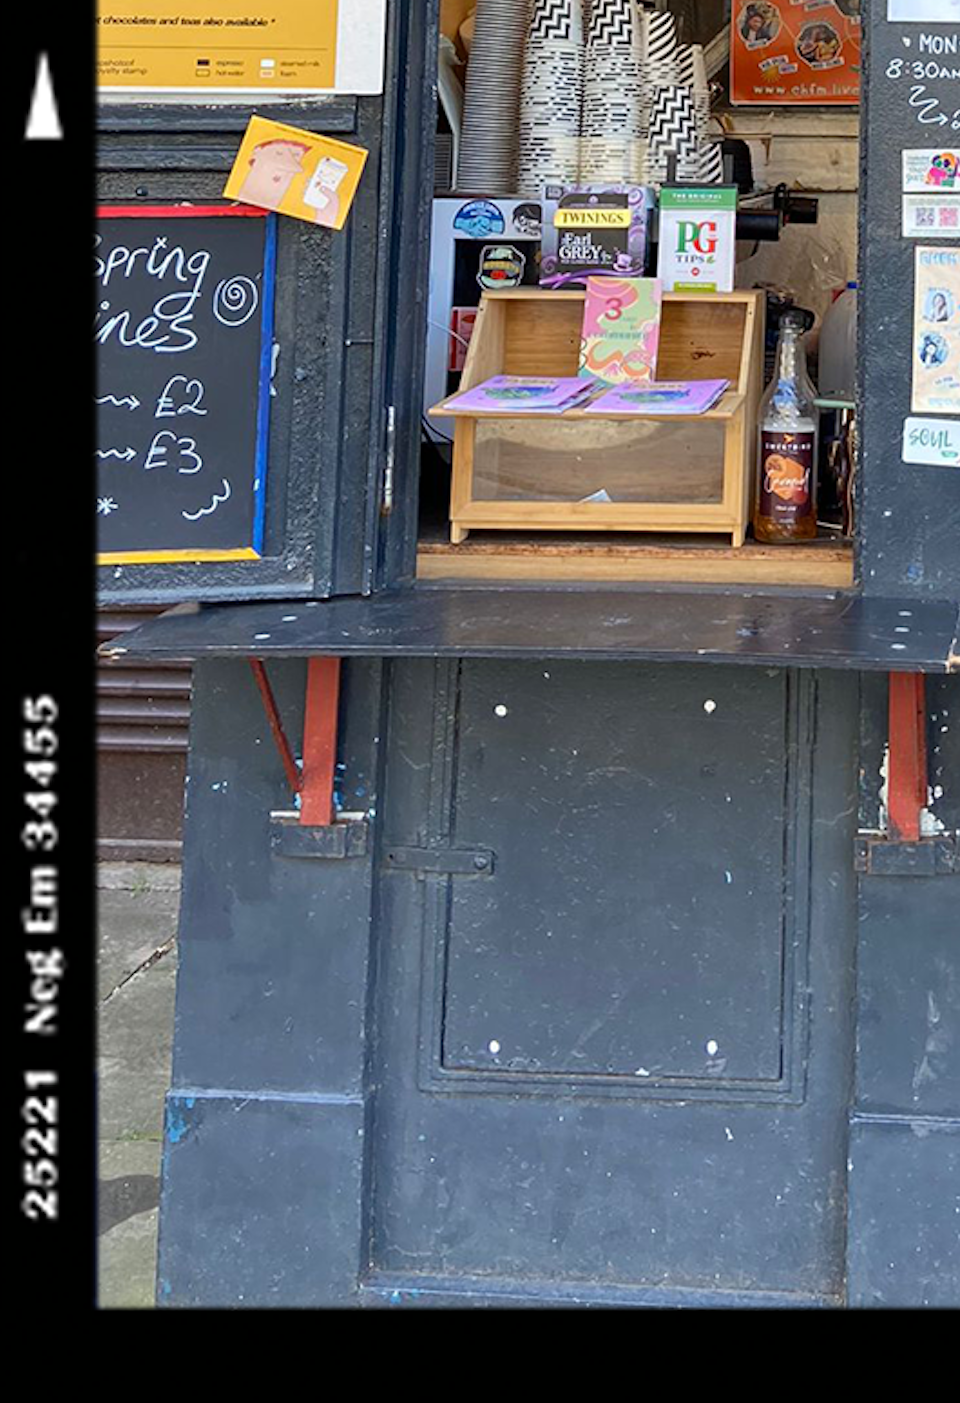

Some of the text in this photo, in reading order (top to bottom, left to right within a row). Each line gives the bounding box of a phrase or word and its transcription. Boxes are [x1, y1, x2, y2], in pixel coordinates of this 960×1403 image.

[103, 16, 156, 26] chocolates
[159, 17, 179, 26] and
[203, 17, 223, 26] also
[225, 18, 268, 27] available
[920, 33, 957, 55] MON
[563, 212, 624, 224] TWININGS
[561, 232, 592, 247] Earl
[674, 221, 719, 254] PG
[558, 244, 602, 259] GREY
[675, 254, 704, 264] TIPS
[95, 301, 198, 352] ines
[155, 375, 207, 418] £2
[144, 430, 203, 474] £3
